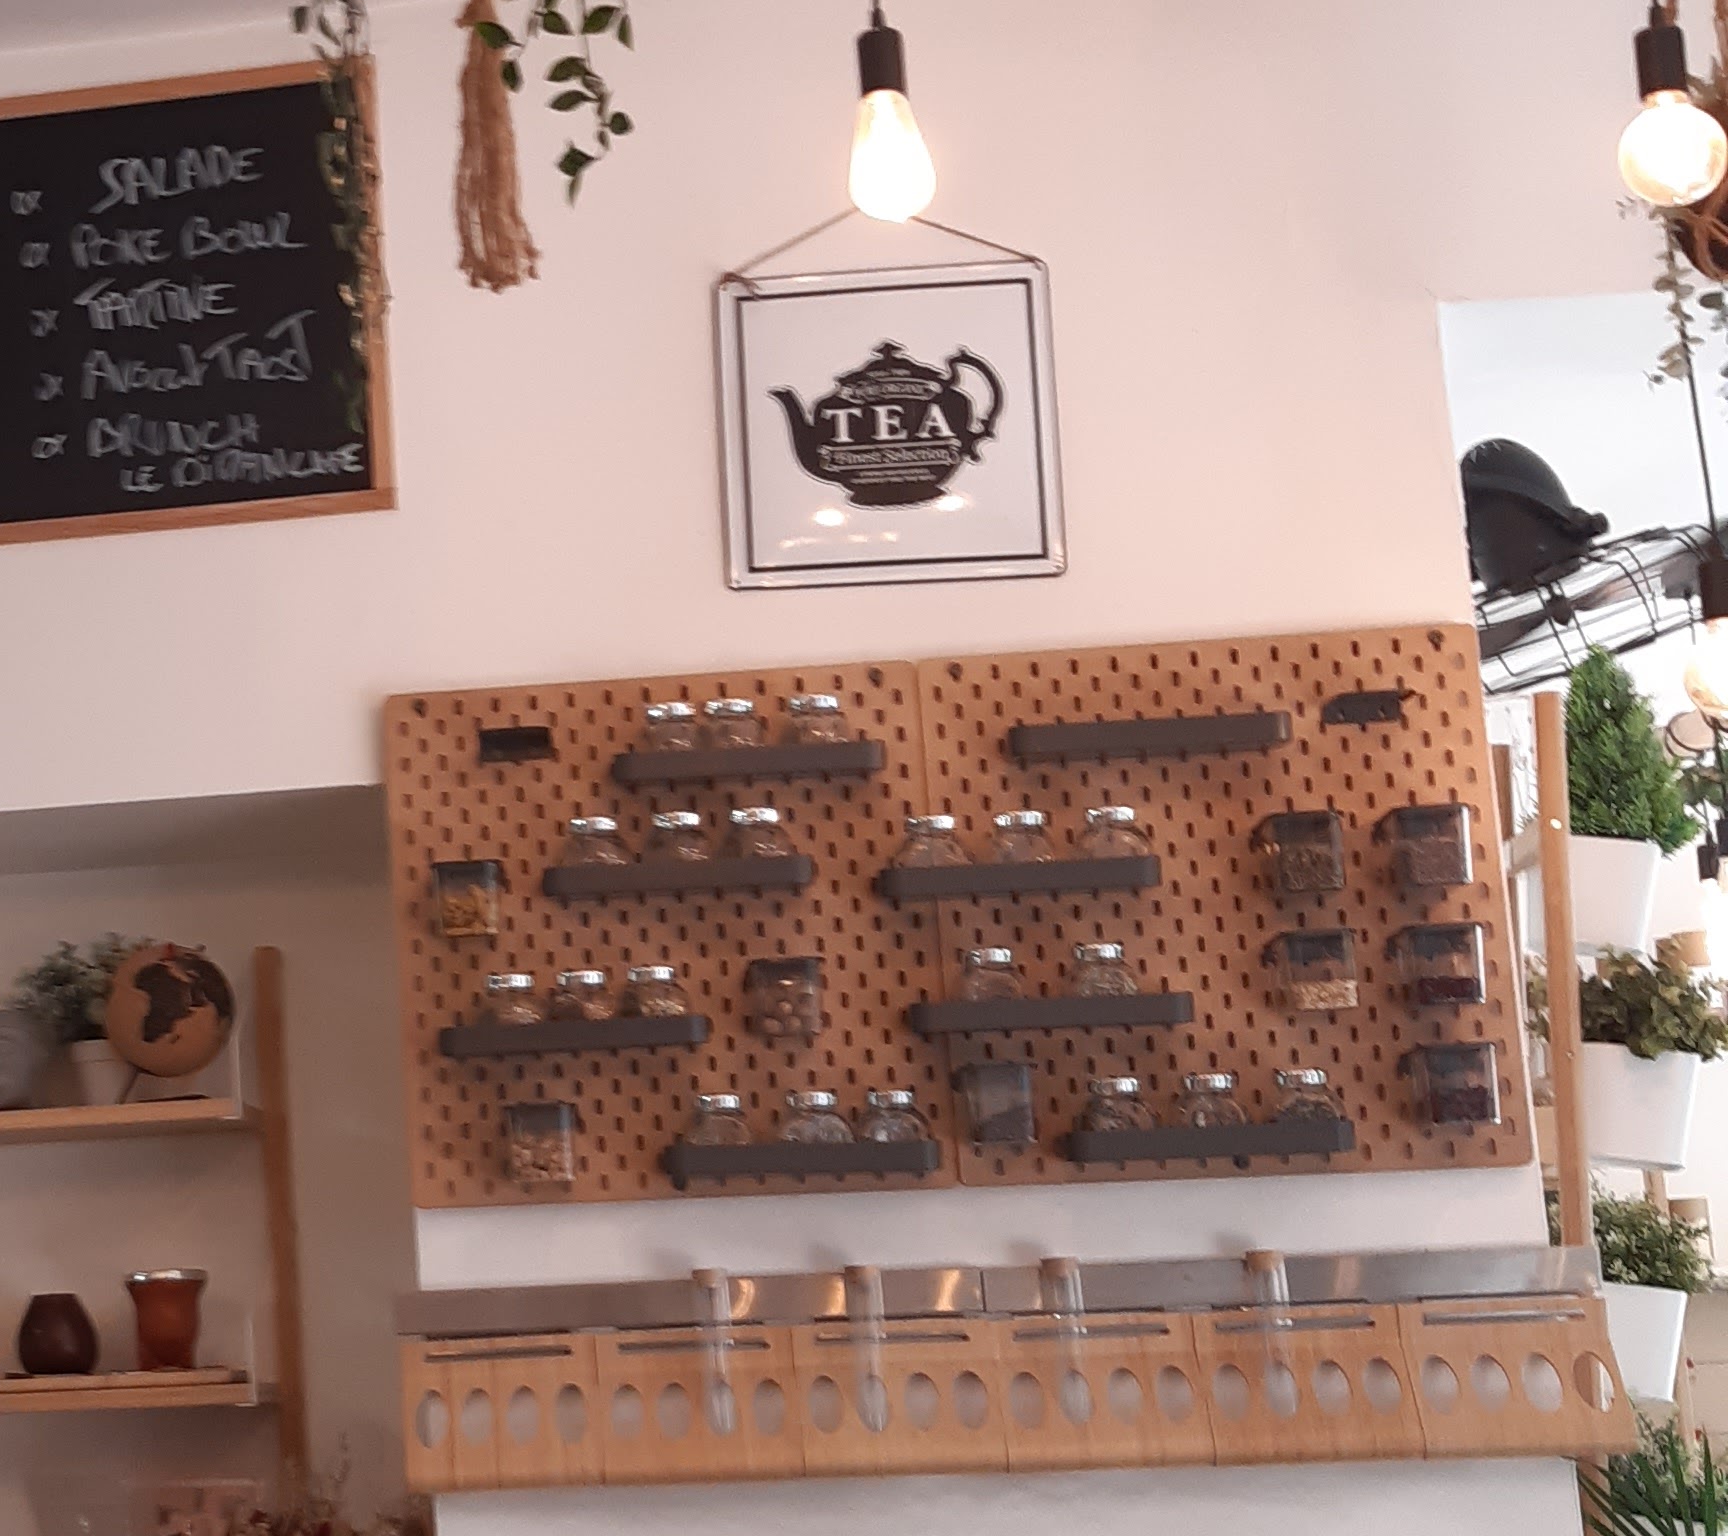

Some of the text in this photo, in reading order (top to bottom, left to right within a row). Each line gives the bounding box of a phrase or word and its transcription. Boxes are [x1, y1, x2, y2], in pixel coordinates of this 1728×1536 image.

[88, 145, 264, 214] SALADE
[71, 212, 309, 270] POKE BOWL
[73, 277, 240, 332] TARTINE
[86, 413, 260, 458] BRUNCH
[820, 404, 957, 443] TEA
[172, 442, 365, 490] DIMANCHE
